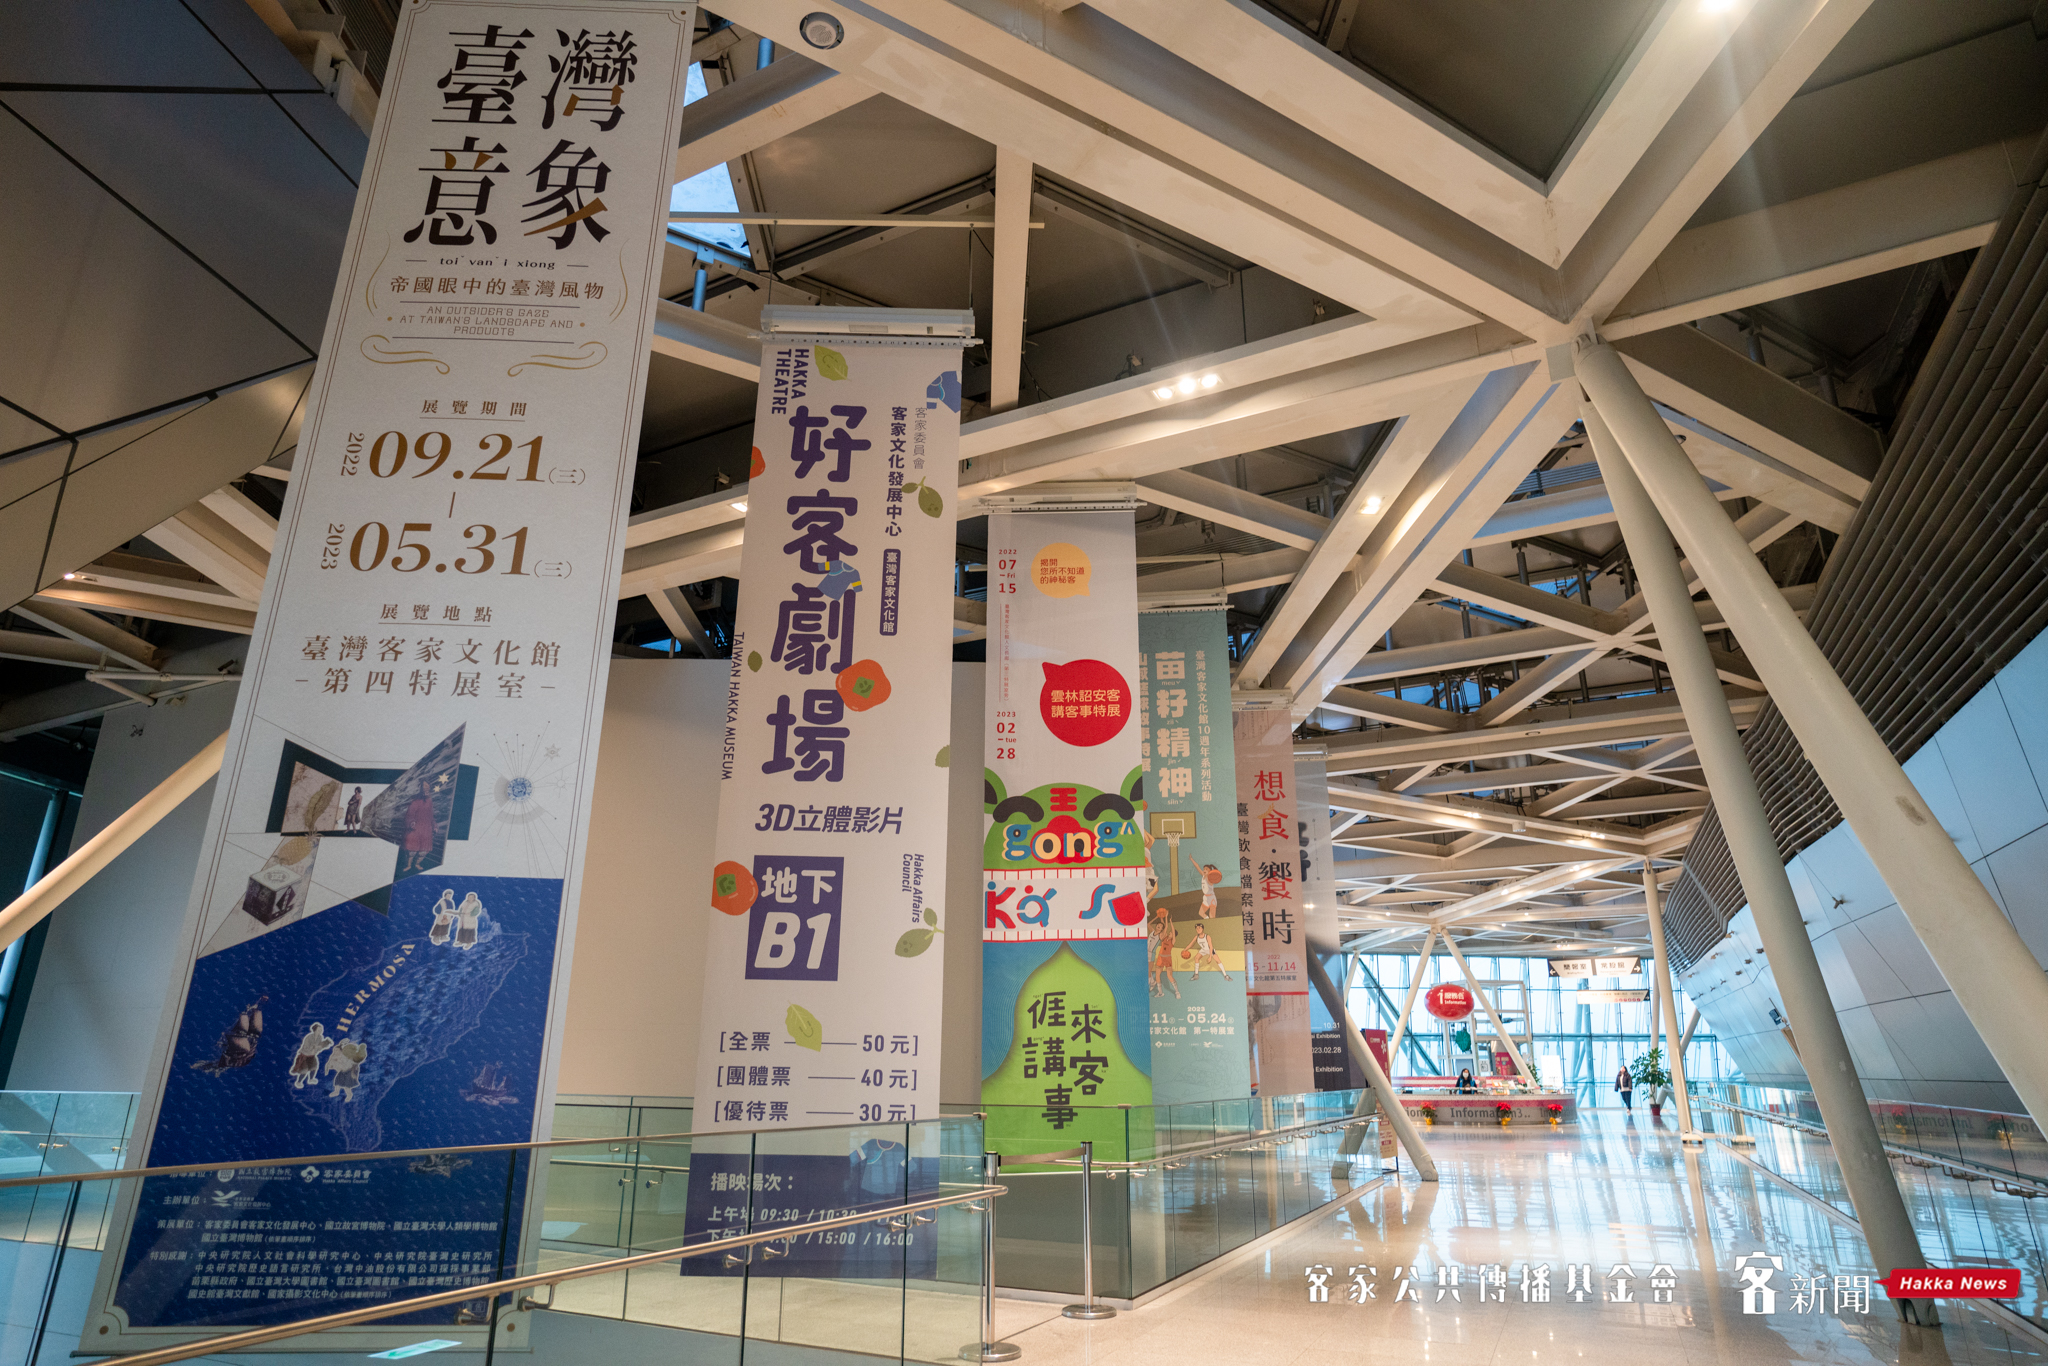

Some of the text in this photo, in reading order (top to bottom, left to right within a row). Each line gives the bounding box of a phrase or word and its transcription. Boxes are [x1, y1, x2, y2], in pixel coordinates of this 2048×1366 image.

[432, 24, 638, 131] 臺灣
[403, 136, 612, 250] 意象
[517, 259, 556, 270] xiong
[390, 275, 605, 300] 帝國眼中的臺灣風物
[400, 315, 574, 329] AT TAIWAN'S LANDSCAPE AND
[426, 306, 442, 314] AN
[518, 308, 550, 318] GAZE
[453, 326, 515, 336] PRODUCTS
[771, 349, 792, 415] THEATRE
[791, 348, 809, 399] HAKKA
[420, 399, 527, 417] 展覽期間
[340, 431, 365, 477] 2022
[913, 406, 928, 470] 客家委員會
[885, 406, 908, 538] 客家文化發展中心
[320, 523, 345, 570] 2023
[1040, 558, 1058, 567] 揭開
[1039, 575, 1076, 584] 的神秘客
[1040, 566, 1085, 576] 您所不知道
[762, 404, 872, 783] 好客劇場
[883, 550, 899, 634] 臺灣客家文化館
[998, 582, 1016, 594] 15
[380, 603, 493, 623] 展覽地點
[300, 635, 561, 668] 臺灣客家文化館
[721, 632, 745, 781] TAIWAN HAKKA MUSEUM
[1050, 688, 1121, 703] 雲林詔安客
[1050, 703, 1121, 718] 講客事特展
[1155, 651, 1193, 798] 苗籽精神
[1195, 650, 1212, 802] 臺灣客家文化館10週年系列活動
[996, 747, 1016, 759] 28
[754, 803, 904, 834] 3D立體影片
[760, 866, 837, 905] 地下
[901, 853, 913, 892] Council
[911, 853, 925, 924] Hakka Affairs
[753, 911, 832, 970] B1
[336, 942, 416, 1033] HERMOSA
[1193, 1026, 1235, 1035] 第一特展室
[323, 1169, 372, 1178] 客家委員會
[760, 1208, 800, 1221] 09:30
[818, 1231, 856, 1245] 15:00
